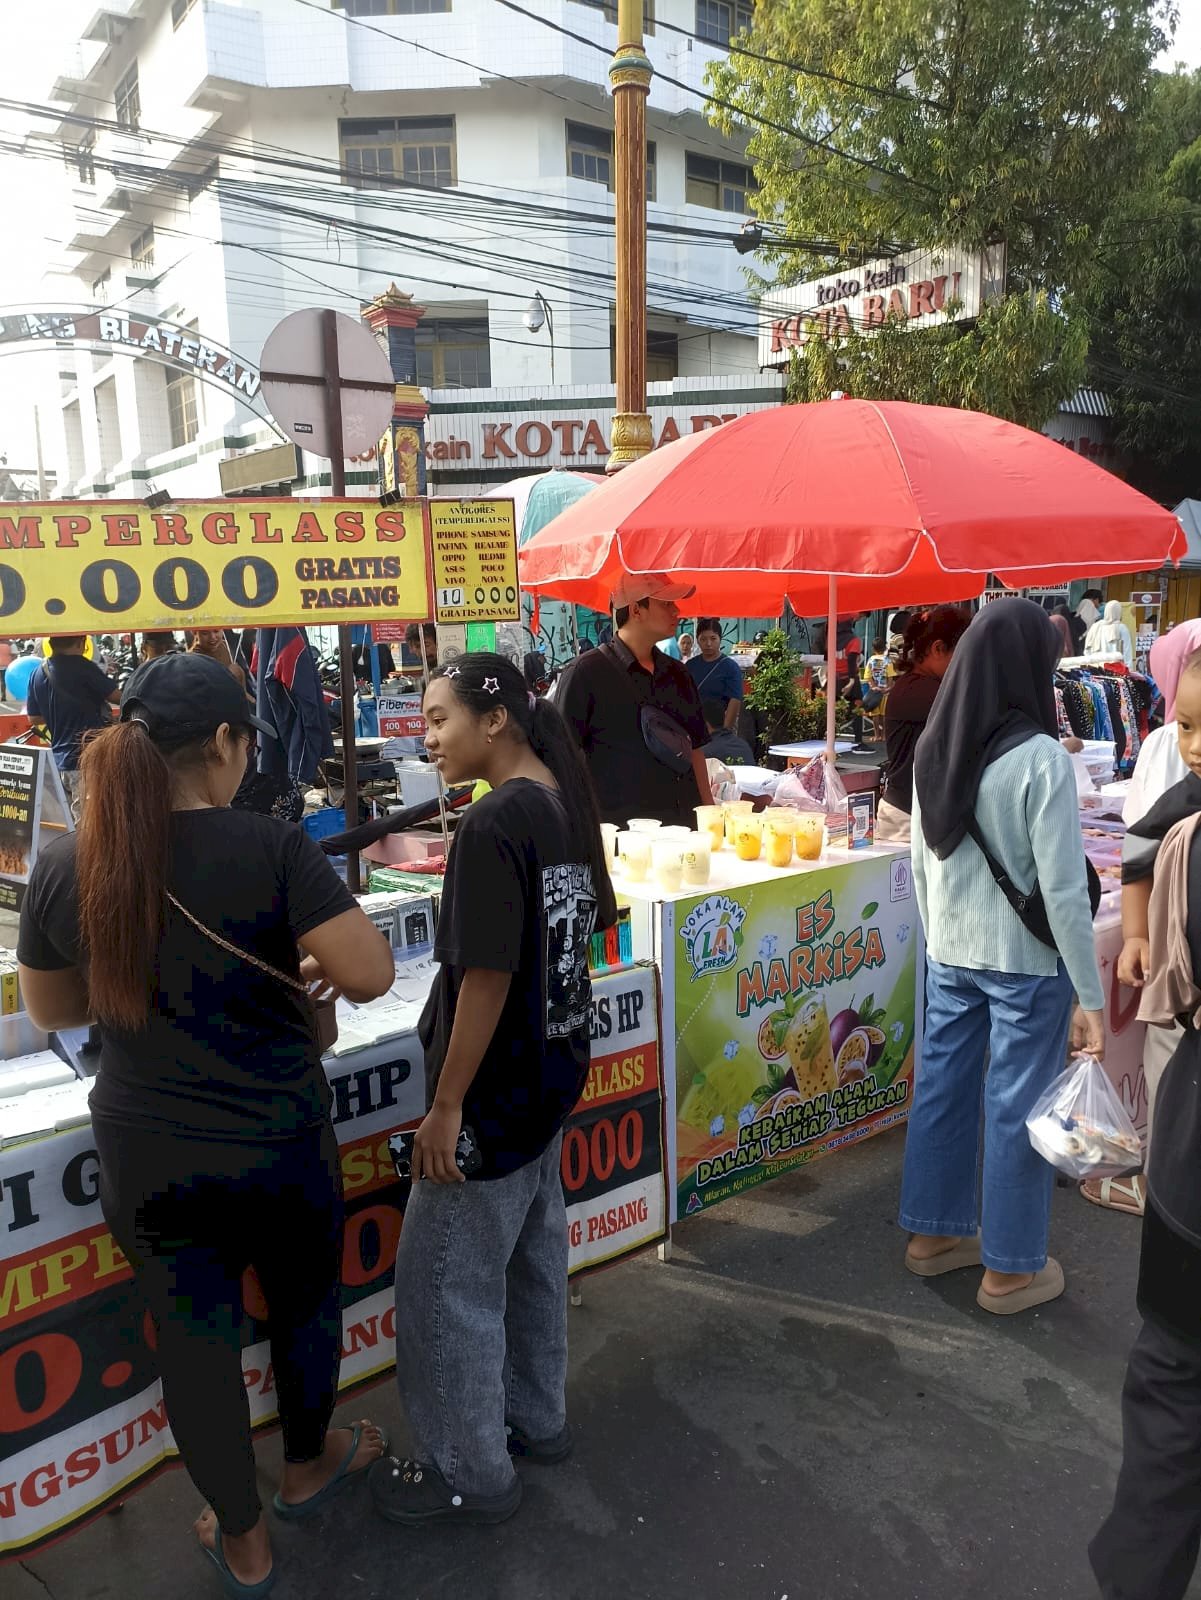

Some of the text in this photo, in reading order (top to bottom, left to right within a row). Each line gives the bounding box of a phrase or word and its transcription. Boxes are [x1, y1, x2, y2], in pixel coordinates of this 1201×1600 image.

[816, 262, 906, 305] toko kain
[771, 271, 961, 353] KOTA BARU
[100, 314, 261, 398] BLATERAN
[480, 417, 610, 459] KOTA
[449, 506, 496, 515] ANTIGORES
[0, 511, 406, 549] MPERGLASS
[436, 529, 511, 539] IPHONE SAMSUNG
[474, 540, 509, 550] REALME
[295, 556, 401, 581] GRATIS
[442, 552, 506, 562] OPPO REDMI
[443, 564, 505, 573] ASUS POCO
[301, 585, 400, 609] PASANG
[444, 575, 505, 585] VIVO NOVA
[440, 606, 516, 618] GRATIS PASANG
[682, 902, 711, 936] LOKA
[715, 899, 745, 923] ALAM
[796, 889, 836, 943] ES
[702, 927, 727, 959] LA
[703, 956, 726, 970] FRESH
[615, 989, 644, 1034] HP
[331, 1057, 411, 1121] HP
[832, 1074, 876, 1108] ALAM
[561, 1109, 644, 1191] 000
[698, 1142, 765, 1186] DALAM
[837, 1081, 908, 1126] TEGUKAN
[587, 1196, 649, 1243] PASANG
